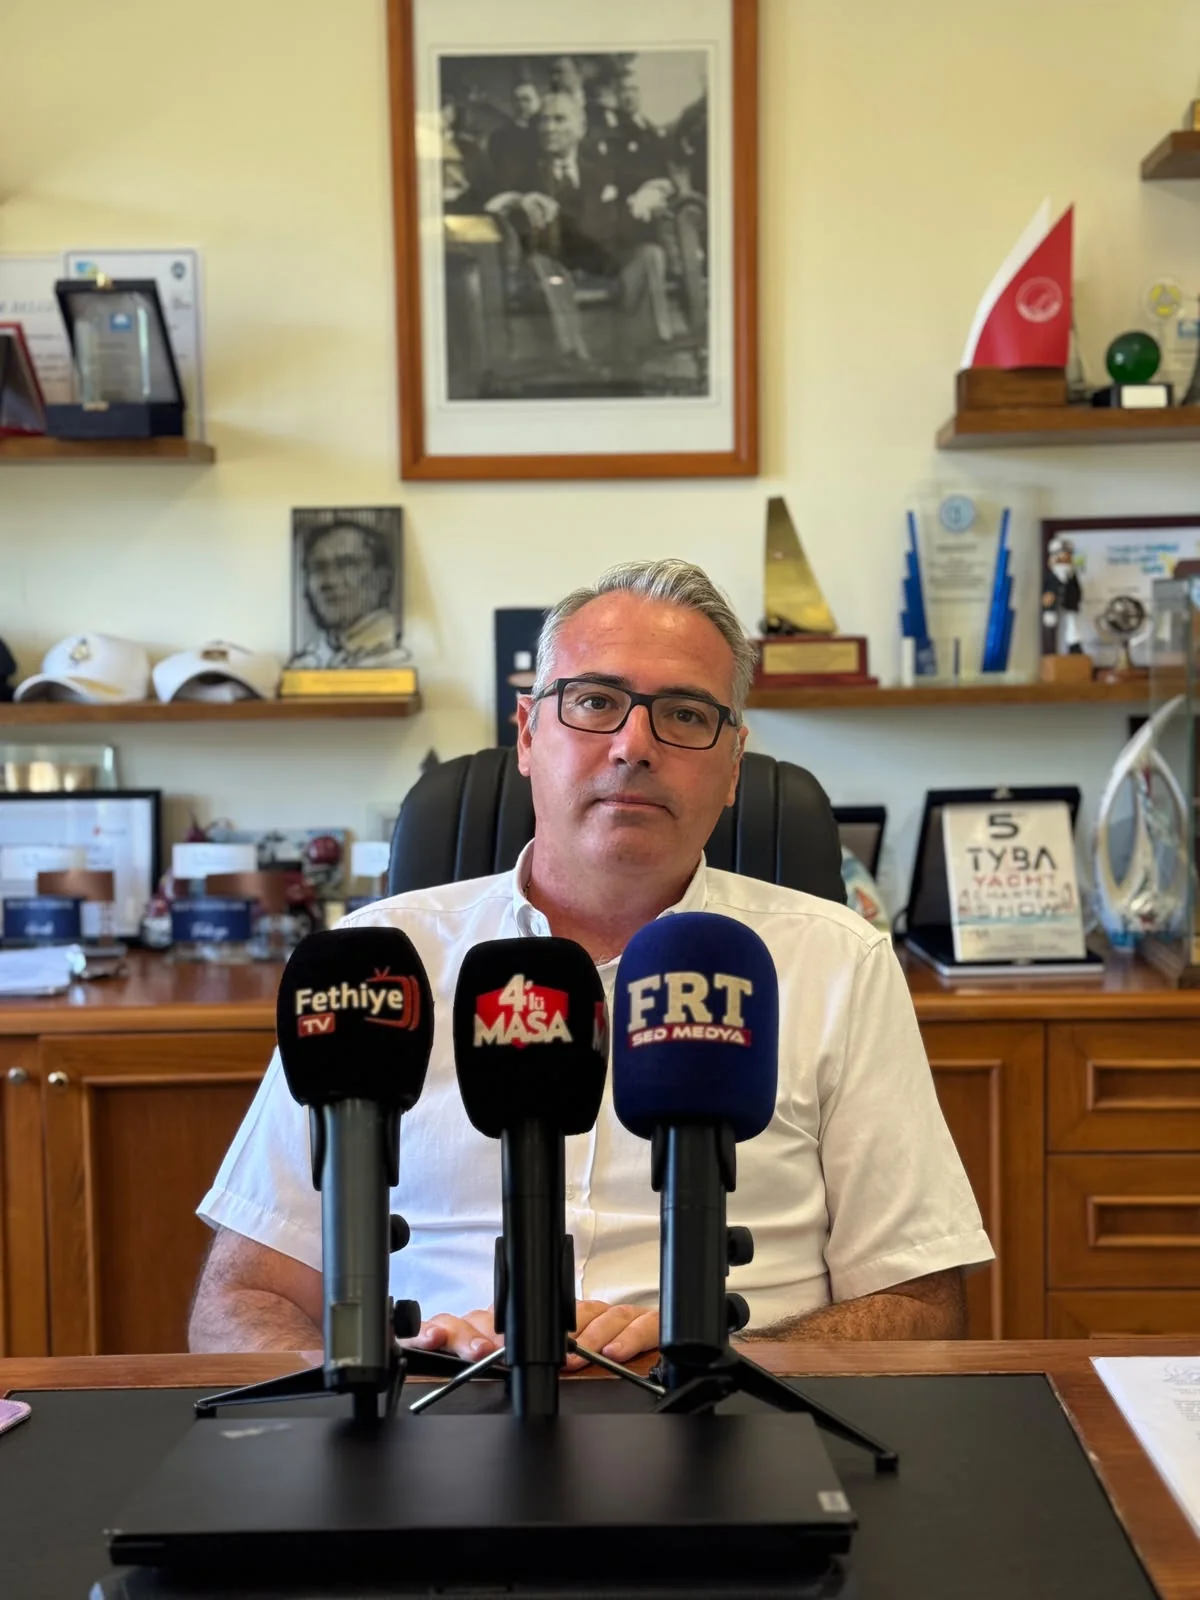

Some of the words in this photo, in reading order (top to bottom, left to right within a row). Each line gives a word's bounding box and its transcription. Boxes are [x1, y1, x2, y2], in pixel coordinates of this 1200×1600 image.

[987, 812, 1021, 840] 5
[974, 874, 1056, 888] YACHT
[295, 982, 404, 1015] Fethiye
[627, 971, 753, 1033] FRT
[303, 1017, 331, 1034] TV
[473, 1009, 574, 1047] MASA
[632, 1028, 668, 1047] SED
[672, 1026, 746, 1045] MEDYA
